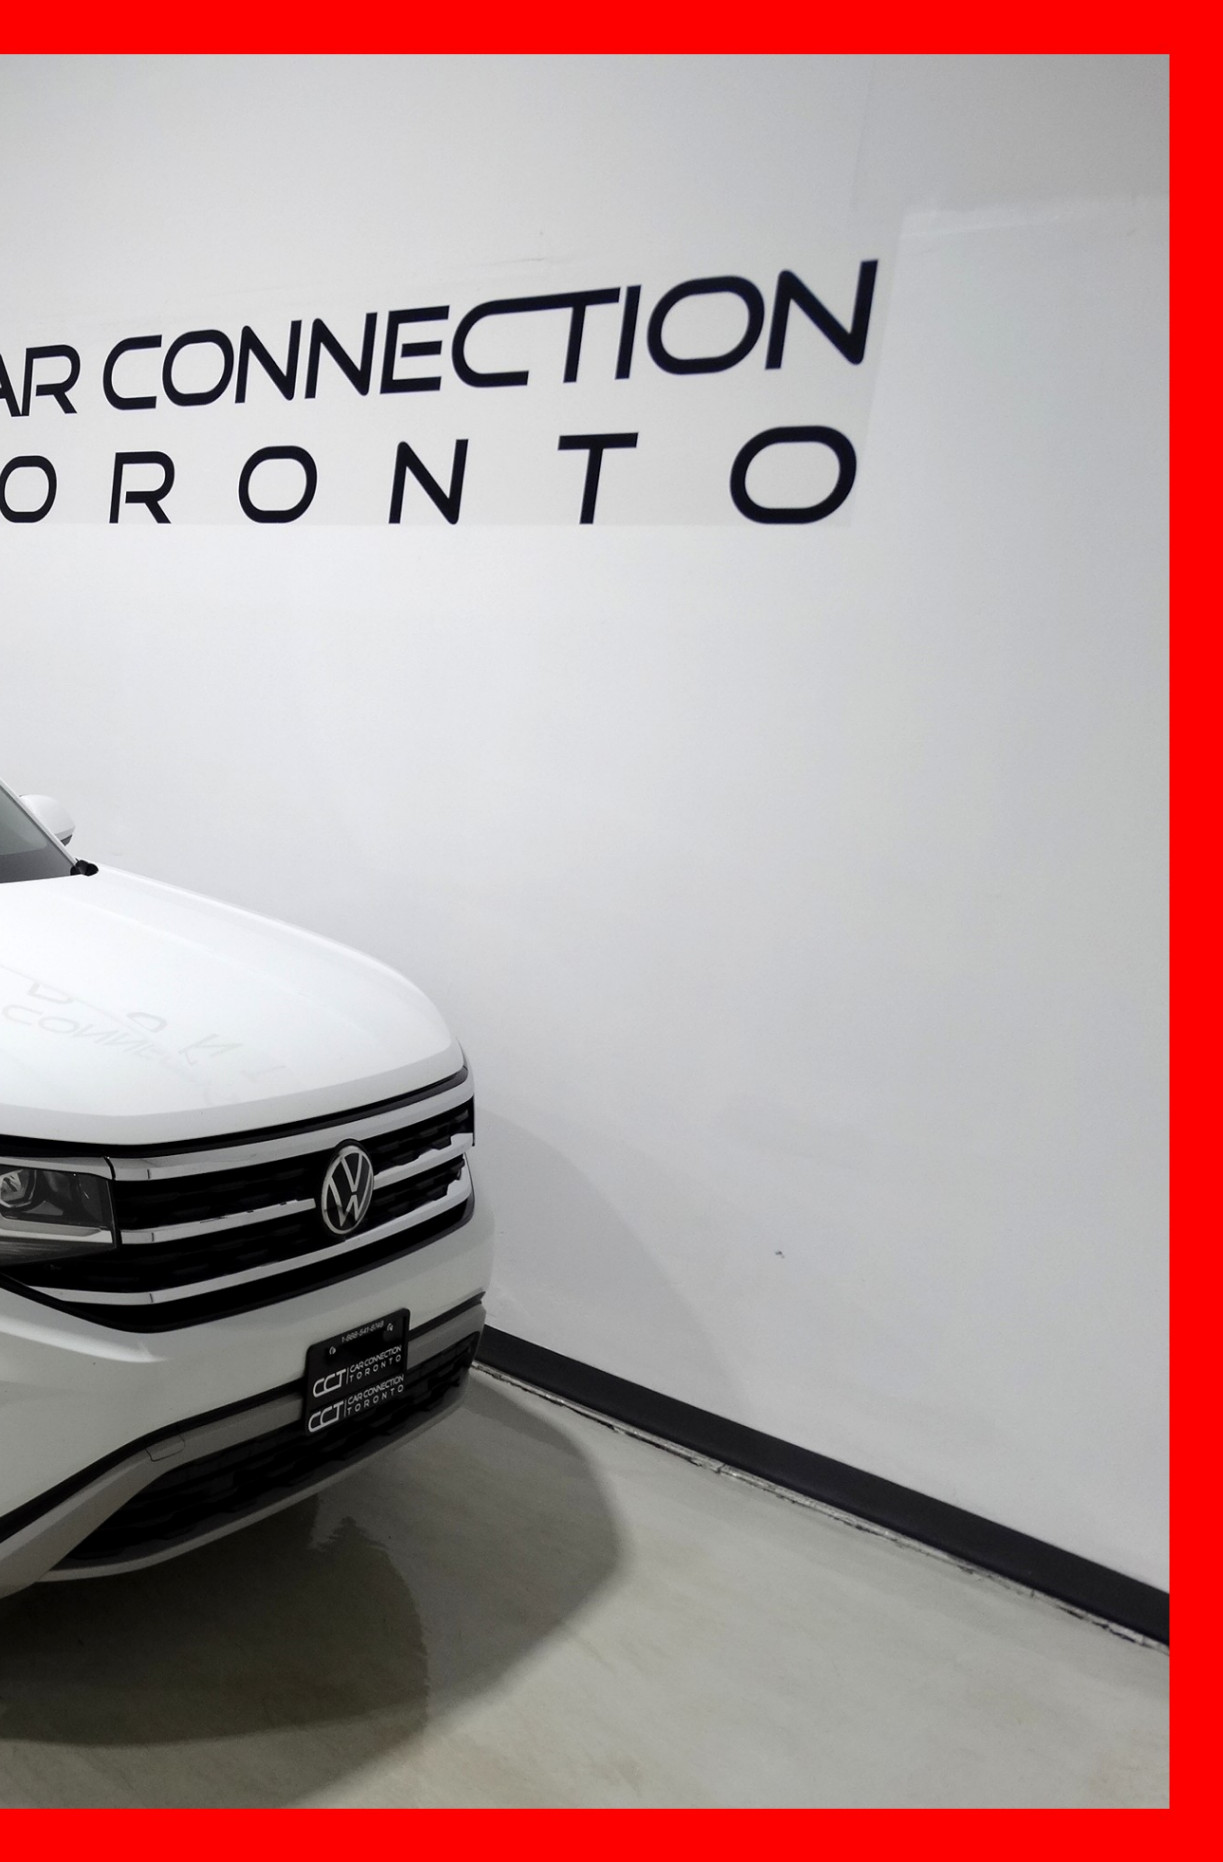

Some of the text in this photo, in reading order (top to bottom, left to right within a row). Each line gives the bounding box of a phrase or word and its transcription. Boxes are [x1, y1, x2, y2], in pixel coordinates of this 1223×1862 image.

[102, 259, 879, 412] CONNECTION
[349, 1345, 402, 1373] CAR CONNECTION
[349, 1354, 402, 1383] TORONTO
[312, 1368, 347, 1398] CCT
[347, 1374, 404, 1405] CAR CONNECTION
[347, 1384, 404, 1416] TORONTO
[307, 1400, 344, 1433] CCT
